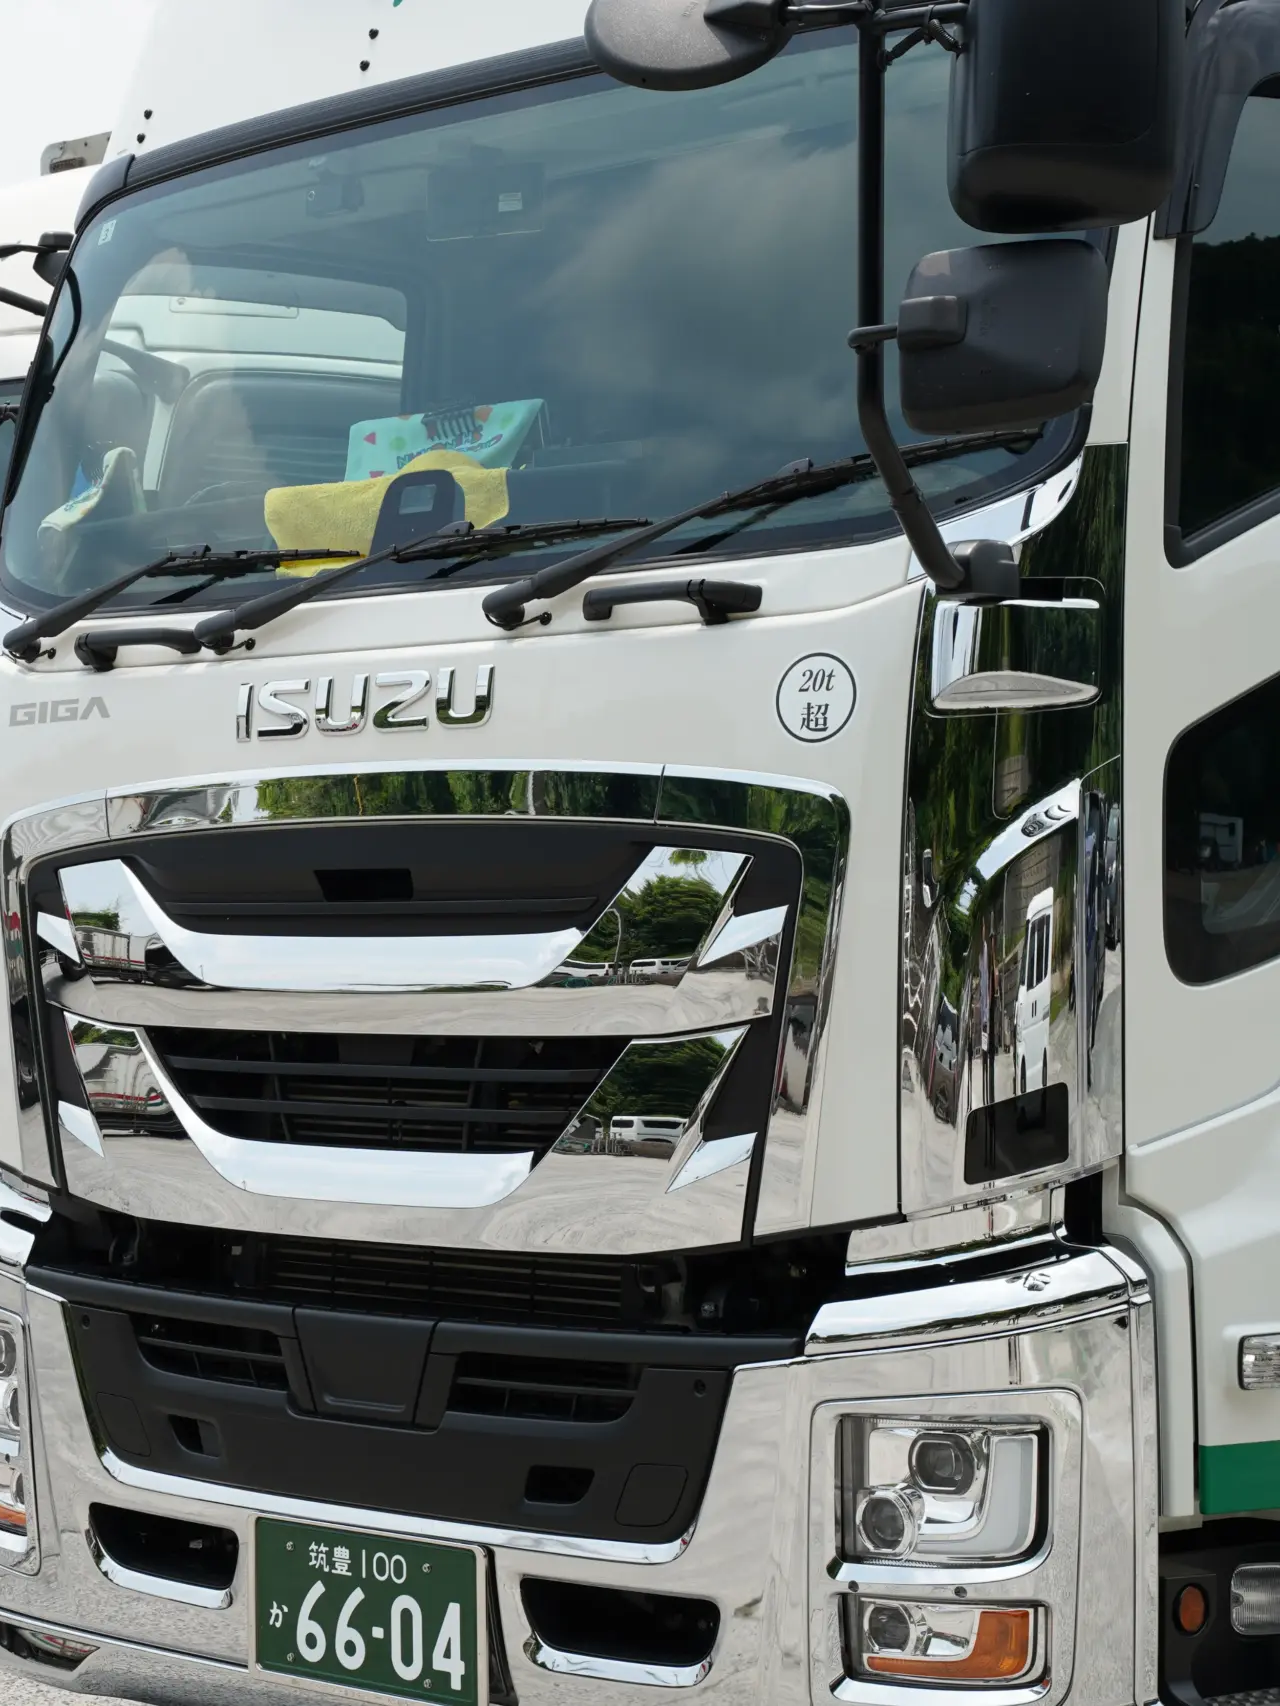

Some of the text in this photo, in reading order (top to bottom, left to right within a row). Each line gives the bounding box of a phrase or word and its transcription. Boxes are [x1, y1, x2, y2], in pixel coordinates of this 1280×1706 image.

[798, 668, 836, 692] 20t
[9, 697, 110, 727] GIGA
[236, 664, 496, 743] ISUZU
[800, 702, 830, 732] 超
[269, 1580, 465, 1691] か 66-04
